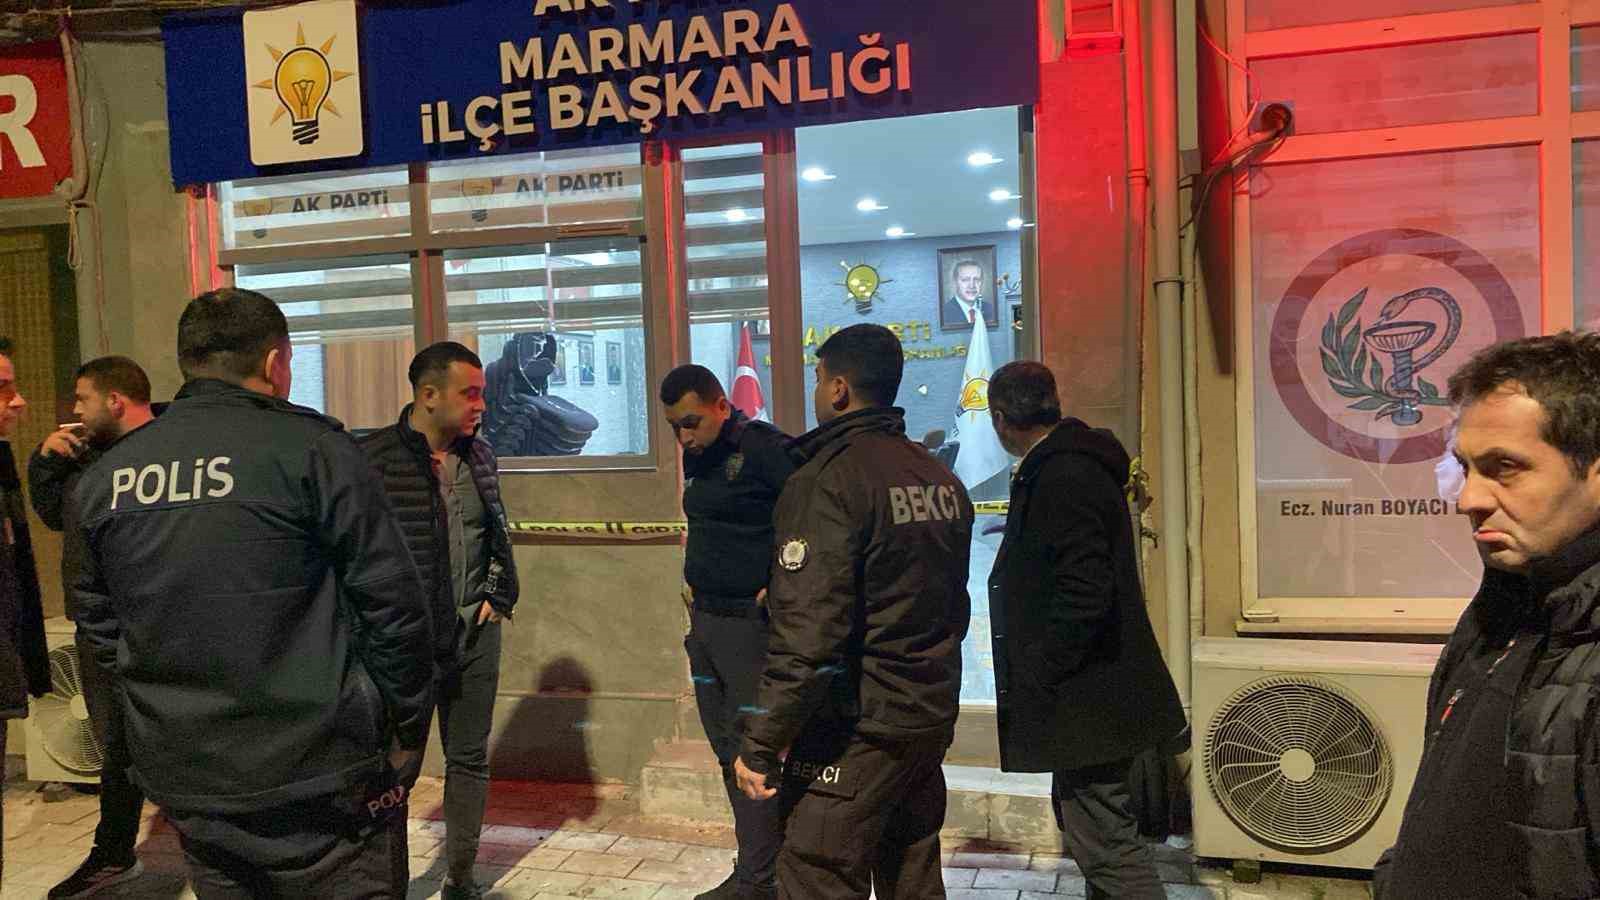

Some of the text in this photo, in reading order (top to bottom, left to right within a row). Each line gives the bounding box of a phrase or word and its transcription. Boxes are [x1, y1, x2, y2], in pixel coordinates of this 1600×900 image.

[501, 4, 810, 83] MARMARA
[548, 32, 911, 134] BAŞKANLIĞI
[292, 195, 321, 213] AK
[1281, 500, 1316, 516] Ecz.
[1321, 499, 1375, 516] Nuran
[1381, 498, 1448, 516] BOYACI
